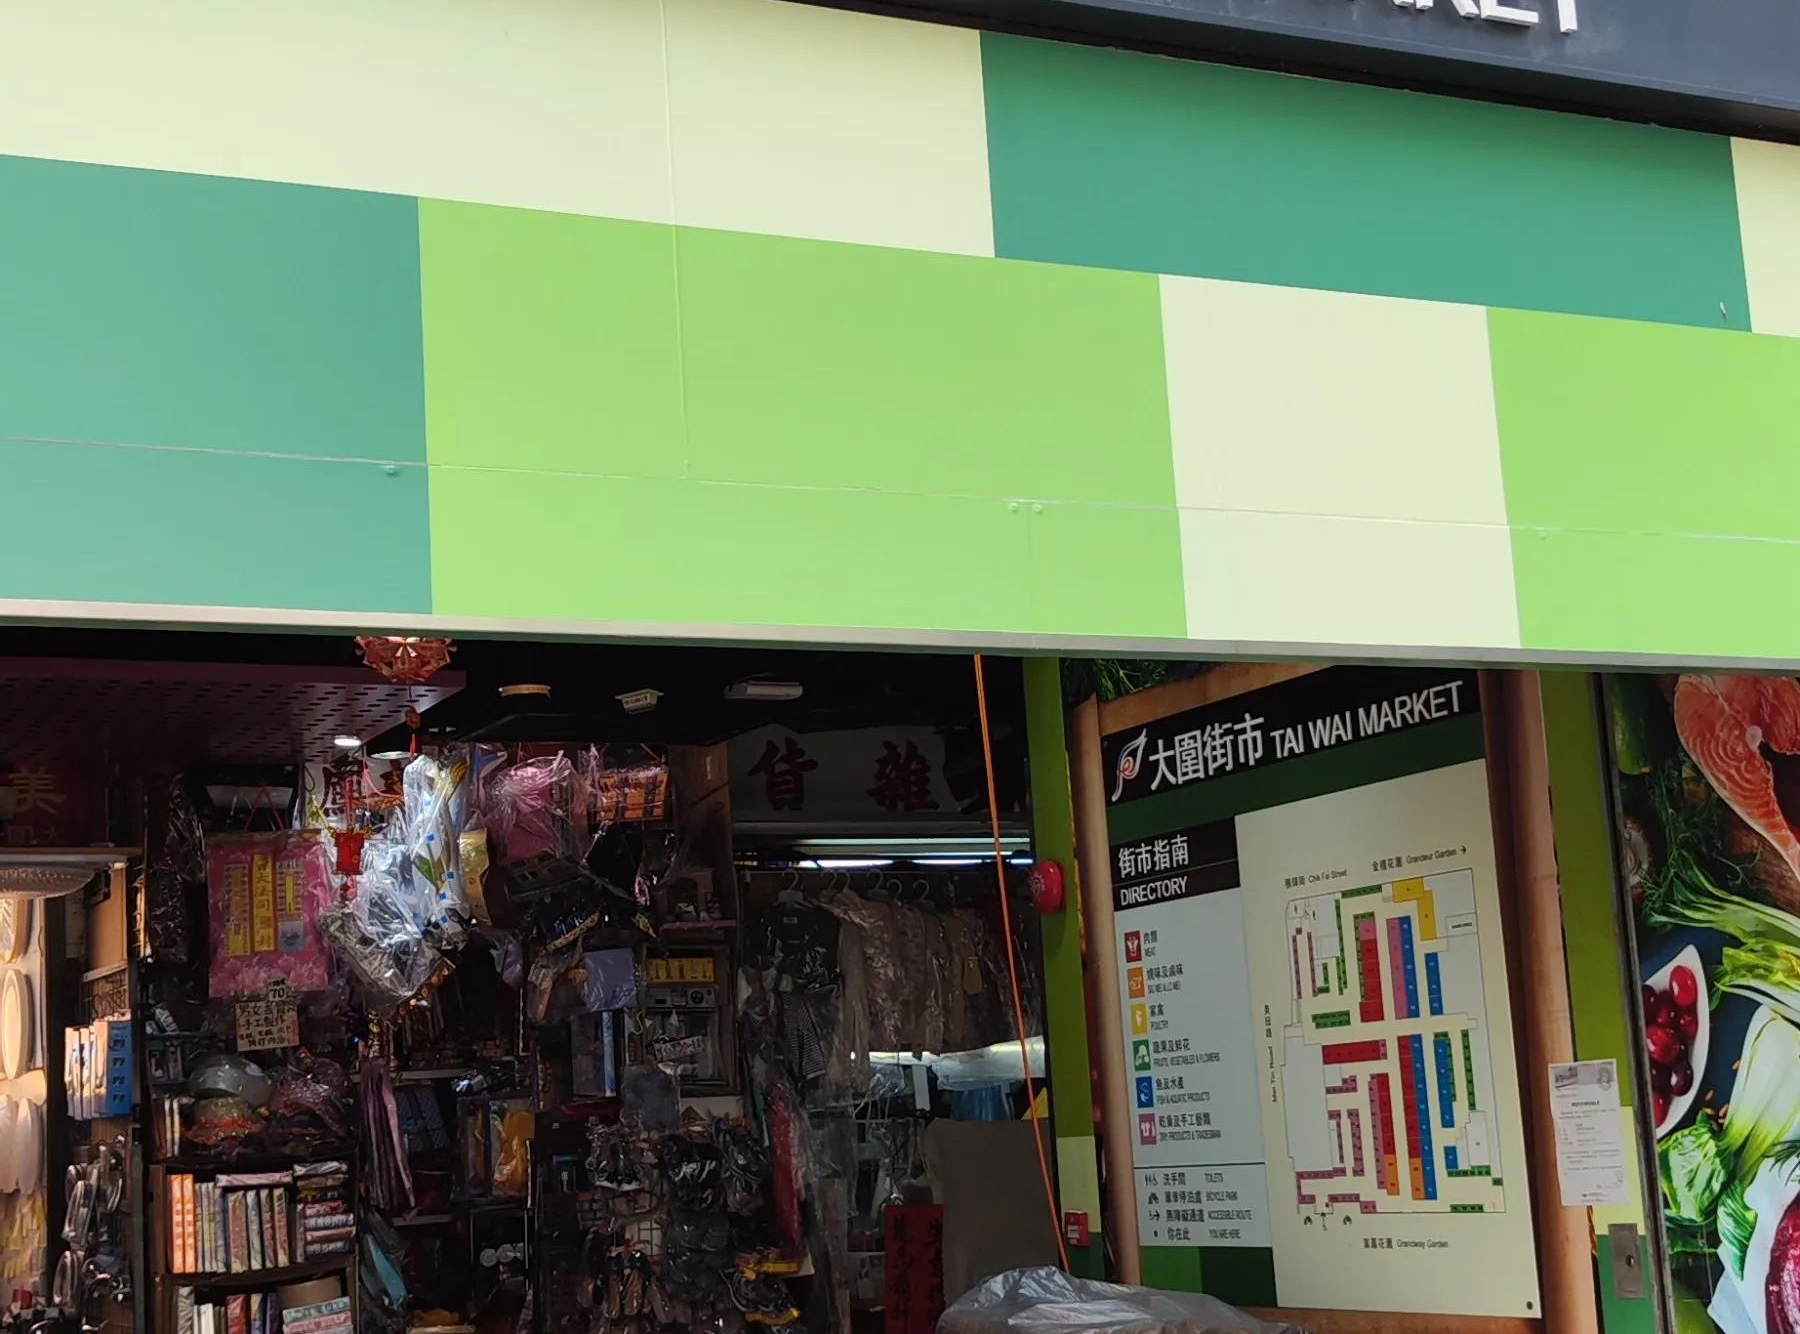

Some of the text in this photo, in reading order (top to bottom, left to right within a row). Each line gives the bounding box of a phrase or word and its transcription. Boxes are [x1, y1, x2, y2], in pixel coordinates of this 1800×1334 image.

[1270, 680, 1463, 759] TAI WAI MARKET
[1149, 713, 1264, 791] 大圍街市
[1118, 834, 1189, 879] 街市指南
[1120, 876, 1188, 906] DIRECTORY
